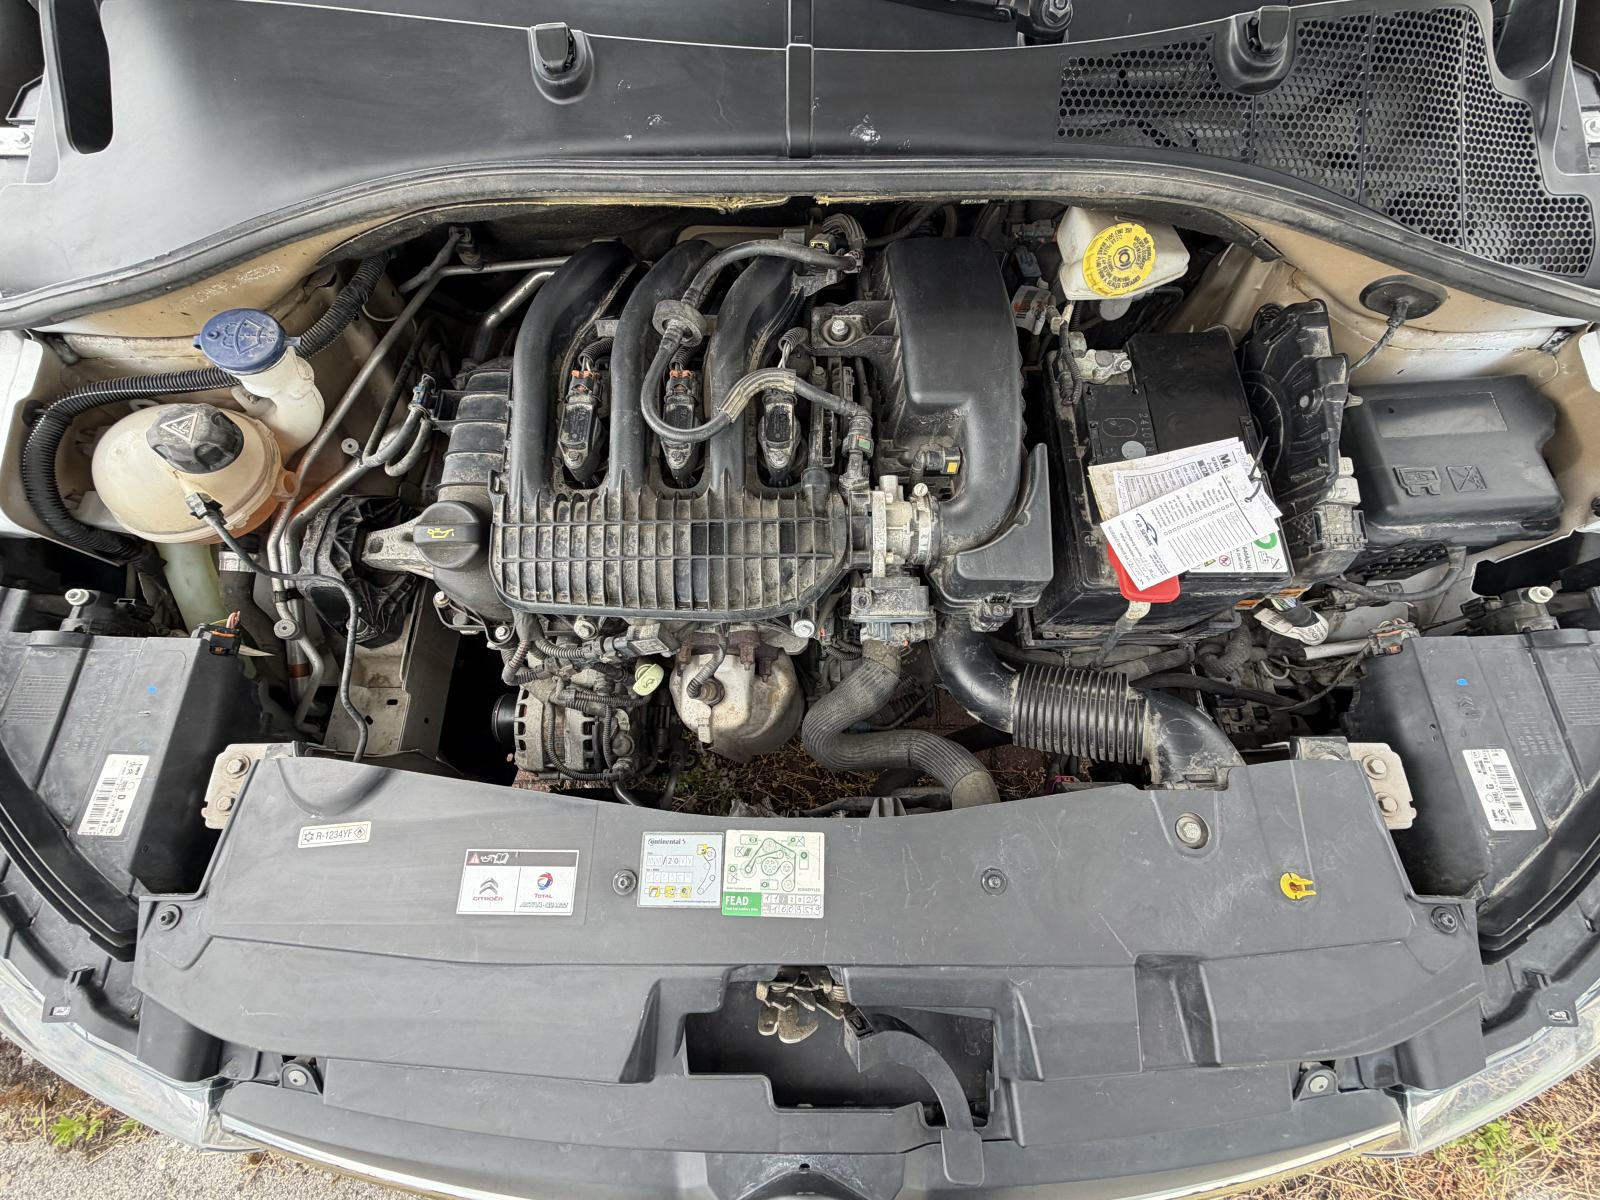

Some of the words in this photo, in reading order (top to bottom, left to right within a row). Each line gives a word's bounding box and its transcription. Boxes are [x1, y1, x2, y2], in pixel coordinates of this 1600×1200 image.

[316, 829, 353, 840] R-1234YF
[648, 838, 681, 846] Continental
[725, 896, 749, 906] FEAD
